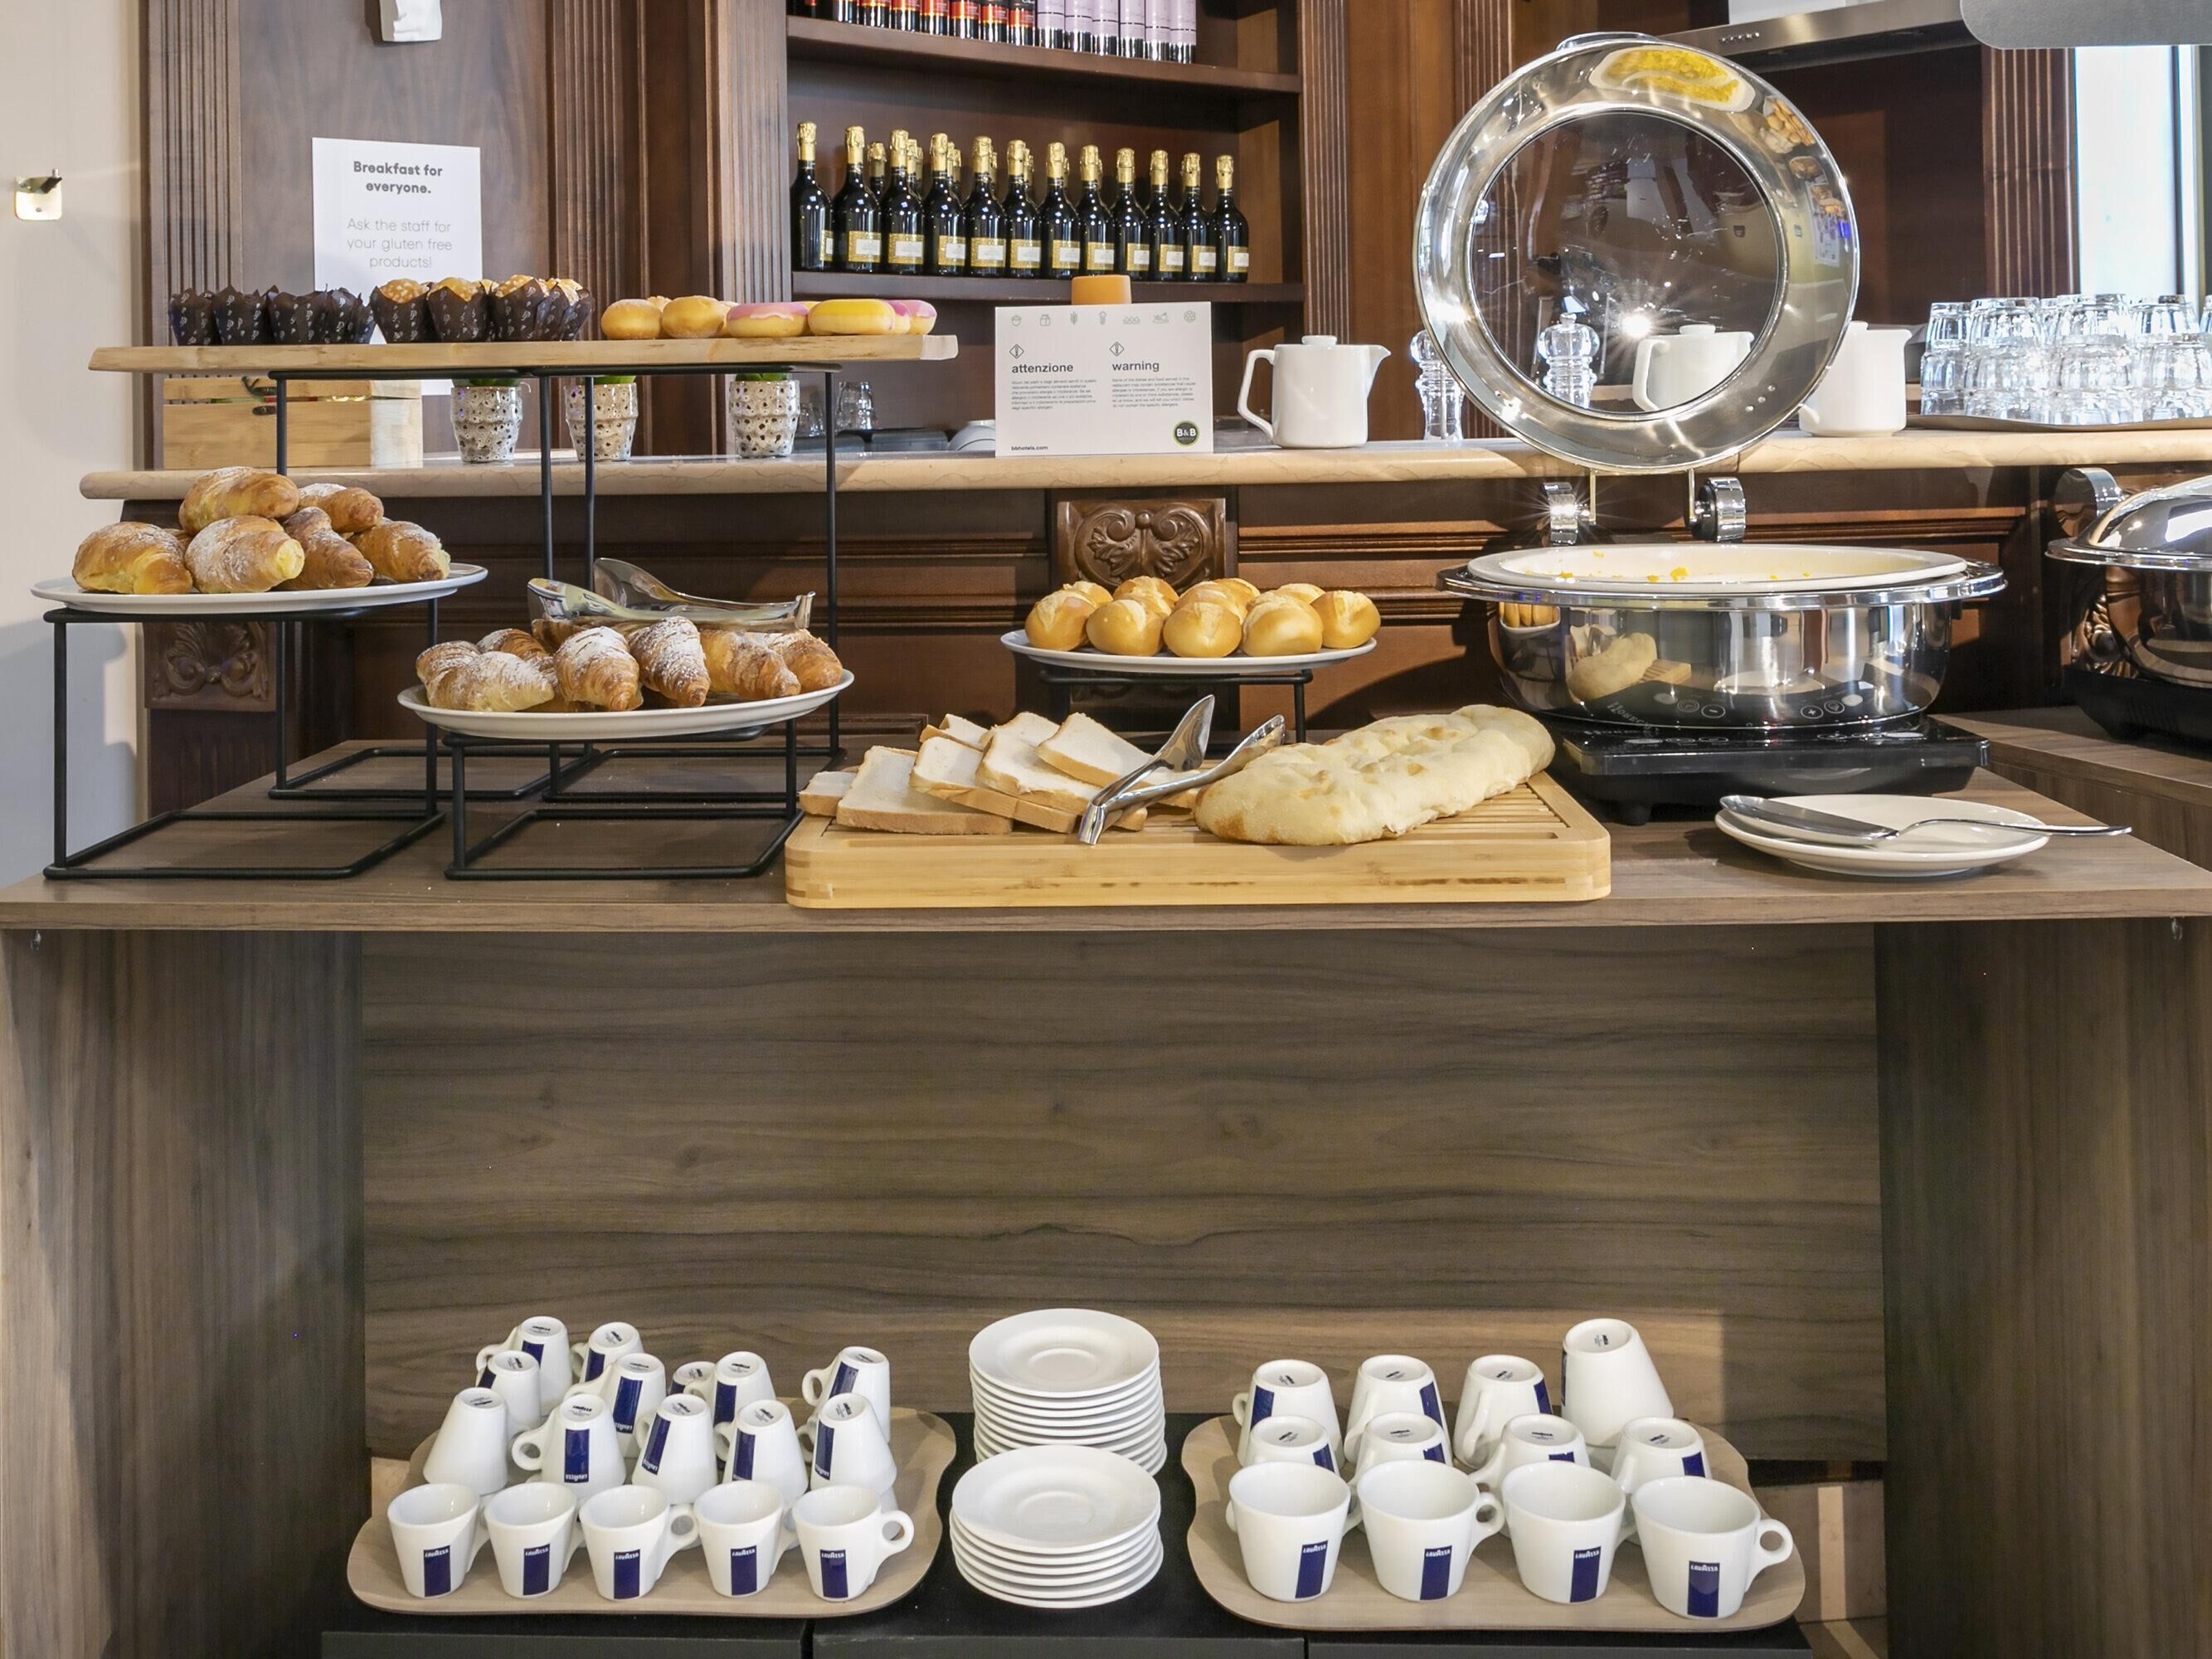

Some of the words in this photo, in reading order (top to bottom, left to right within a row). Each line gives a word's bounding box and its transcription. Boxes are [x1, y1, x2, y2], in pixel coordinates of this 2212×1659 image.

[353, 161, 421, 176] Breakfast
[423, 164, 443, 177] for
[366, 182, 431, 195] everyone.
[347, 217, 370, 230] Ask
[375, 219, 397, 231] the
[401, 220, 430, 233] staff
[434, 221, 451, 233] for
[347, 238, 377, 249] your
[382, 237, 423, 252] gluten
[427, 237, 452, 251] free
[369, 255, 432, 269] products!
[1011, 362, 1074, 373] attenzione
[1111, 360, 1159, 372] warning
[1176, 427, 1196, 437] B&B
[425, 1548, 450, 1558] LAVAZZA
[525, 1547, 549, 1557] LAVAZZA
[732, 1548, 756, 1557] LAVAZZA
[1302, 1544, 1327, 1554] LAVAZZA
[1425, 1549, 1451, 1558] LAVAZZA
[615, 1552, 639, 1561] LAVAZZA
[820, 1550, 845, 1559] LAVAZZA
[1574, 1550, 1600, 1559] LAVAZZA
